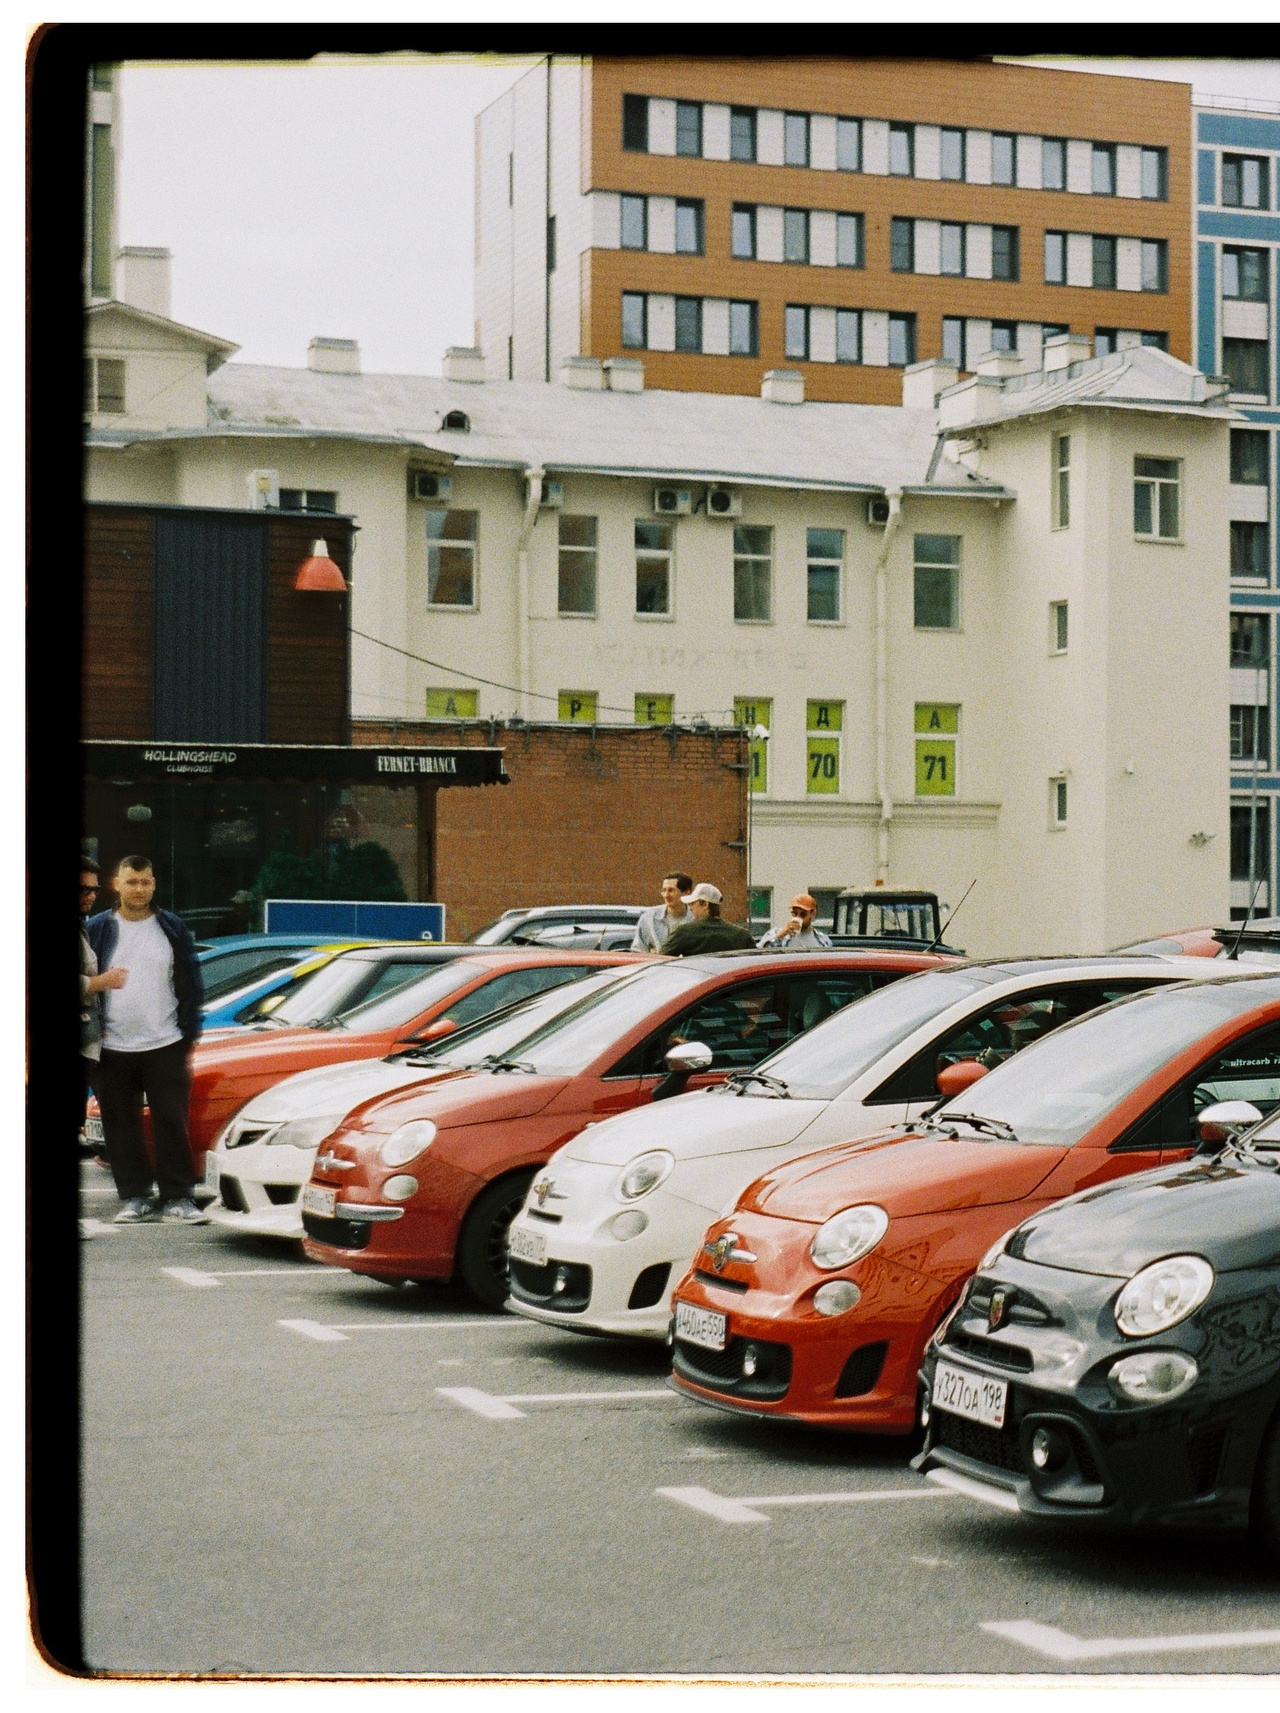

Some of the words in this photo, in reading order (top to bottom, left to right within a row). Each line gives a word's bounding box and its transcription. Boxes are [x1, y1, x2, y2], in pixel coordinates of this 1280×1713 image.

[816, 706, 830, 727] Д
[929, 710, 941, 729] А
[144, 750, 238, 764] HOLLINGSHEAD
[376, 755, 458, 774] FERNET-BRANCA
[166, 764, 214, 774] CLUBHOUSE
[809, 752, 837, 779] 70
[923, 755, 947, 782] 71
[1230, 1057, 1271, 1068] ultracarb
[982, 1382, 1003, 1411] 198
